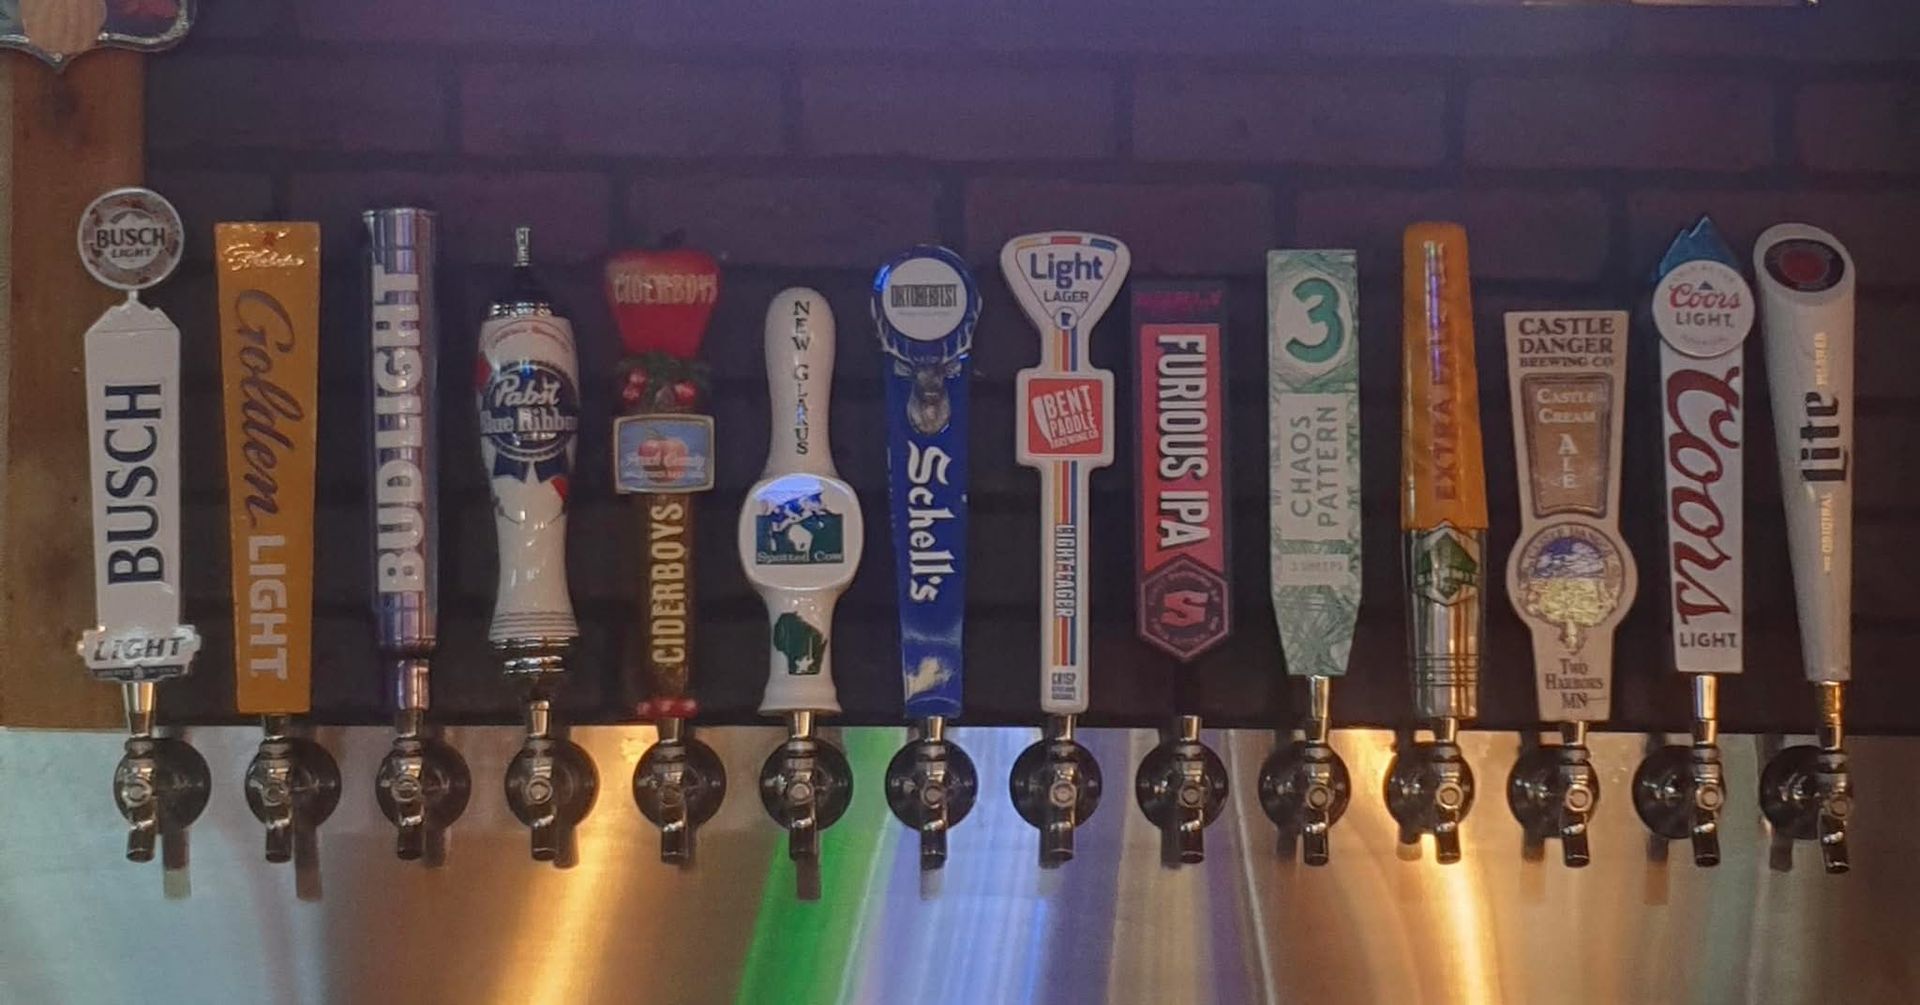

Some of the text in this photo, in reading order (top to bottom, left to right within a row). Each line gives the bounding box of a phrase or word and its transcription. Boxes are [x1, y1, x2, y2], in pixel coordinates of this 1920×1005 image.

[96, 227, 166, 249] BUSCH
[111, 249, 151, 259] LIGHT
[1029, 252, 1104, 290] Light
[1043, 290, 1089, 304] LAGER
[1668, 282, 1741, 309] Coors
[792, 300, 811, 351] NEW
[1284, 276, 1346, 364] 3
[1518, 317, 1616, 336] CASTLE
[1675, 311, 1734, 327] LIGHT
[1518, 337, 1614, 354] DANGER
[1519, 356, 1589, 369] BREWING
[235, 288, 304, 530] Golden
[494, 374, 561, 407] Pabst
[1043, 384, 1092, 420] BENT
[1157, 334, 1210, 479] FURIOUS
[1049, 410, 1097, 438] PADDLE
[1800, 390, 1849, 482] Lite
[1290, 415, 1312, 518] CHAOS
[1316, 406, 1339, 528] PATTERN
[1431, 399, 1457, 500] EXTRA
[104, 384, 164, 585] BUSCH
[1667, 366, 1740, 625] Coors
[907, 439, 956, 602] Schell's
[1159, 489, 1211, 549] IPA
[813, 550, 844, 562] Cow
[651, 502, 687, 665] CIDERBOYS
[1055, 571, 1077, 618] LAGER
[248, 534, 288, 681] LIGHT
[93, 636, 187, 662] LIGHT
[1679, 632, 1738, 648] LIGHT
